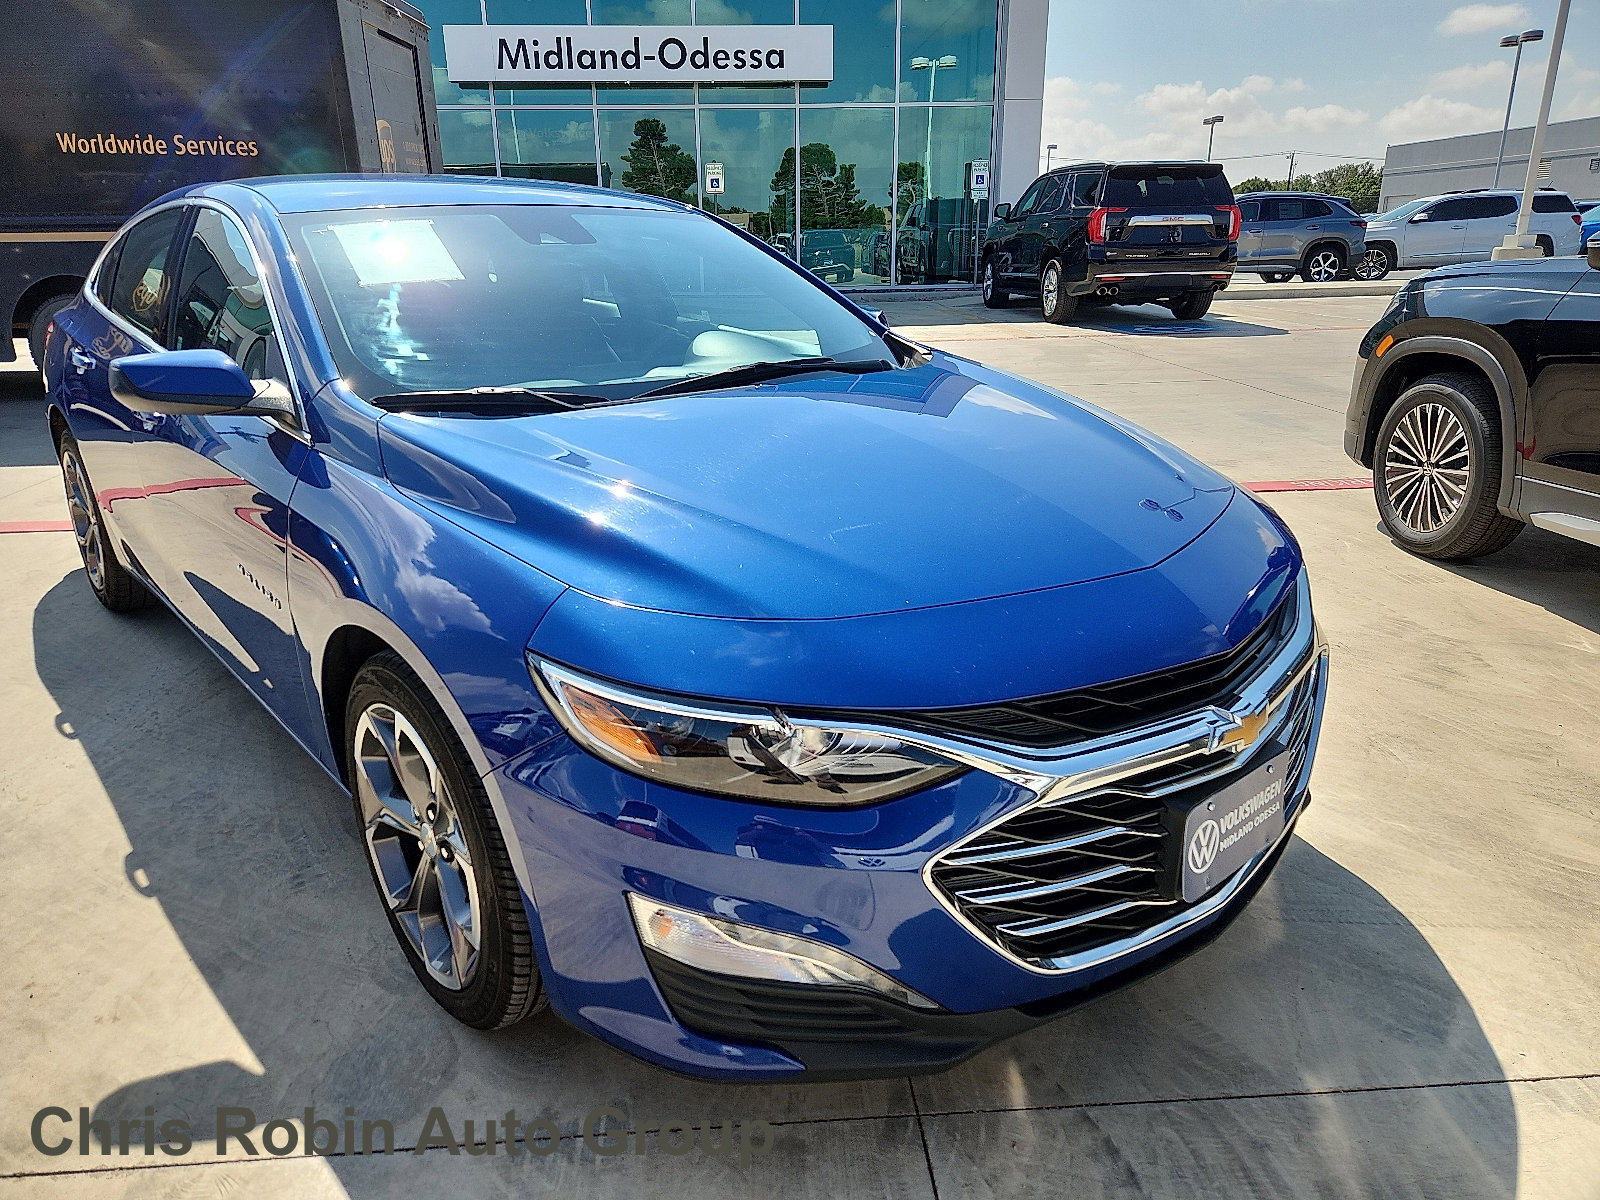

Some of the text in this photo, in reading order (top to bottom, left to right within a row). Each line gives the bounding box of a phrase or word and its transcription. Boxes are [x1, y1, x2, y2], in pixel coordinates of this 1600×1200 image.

[497, 36, 785, 70] Midland-Odessa
[55, 132, 259, 157] Worldwide Services
[1219, 778, 1282, 834] VOLKSWAGEN
[1219, 801, 1281, 853] MIDLAND ODESSA
